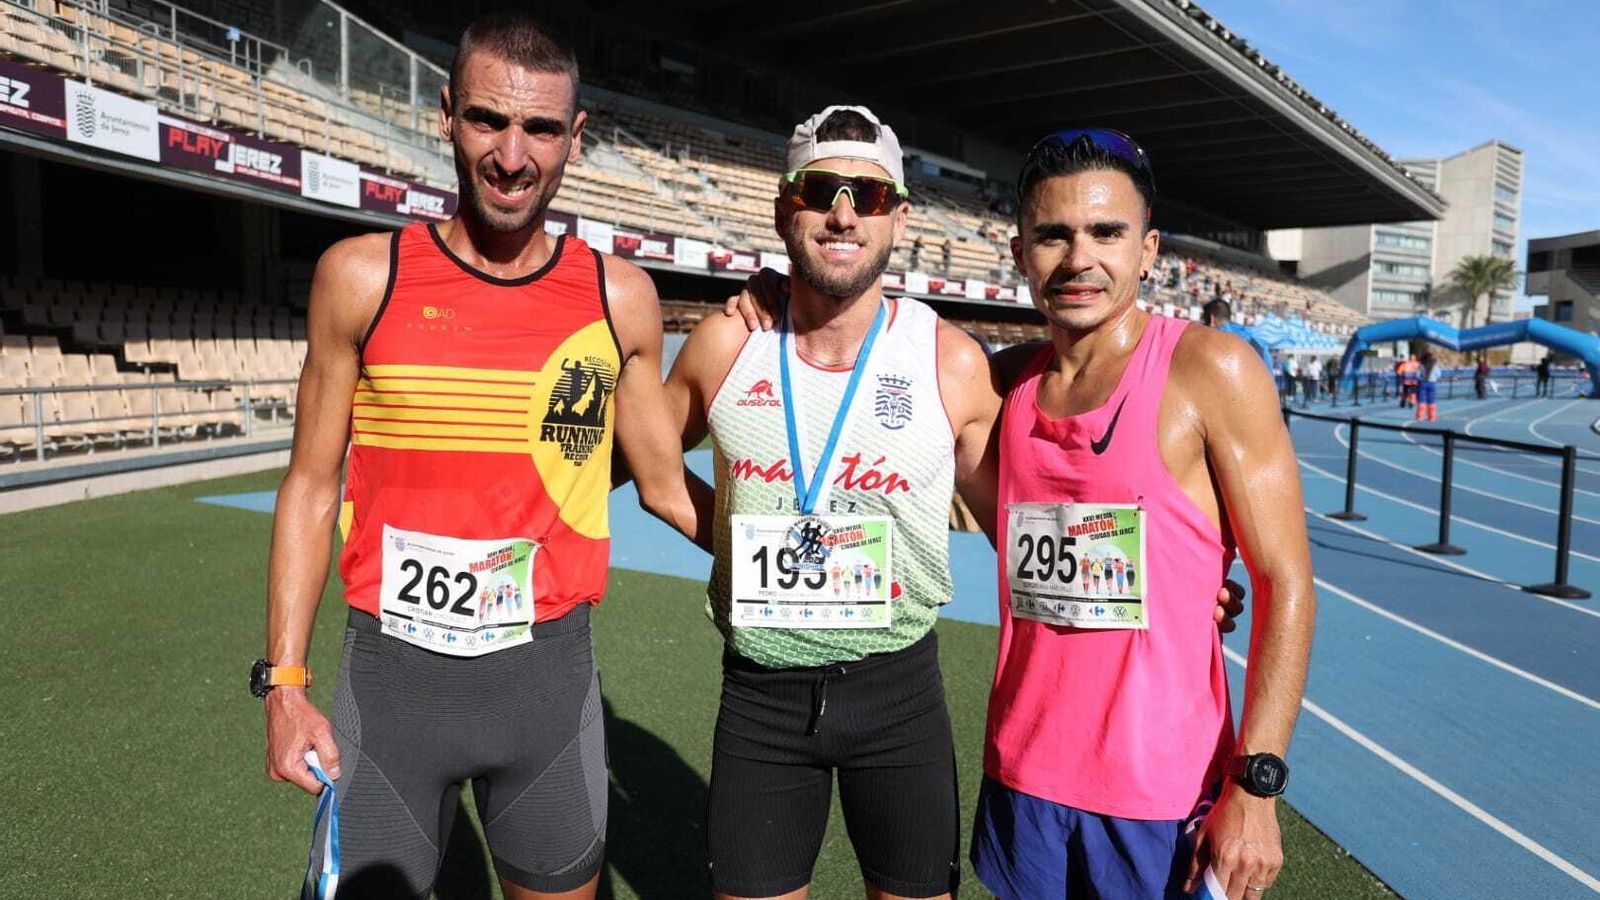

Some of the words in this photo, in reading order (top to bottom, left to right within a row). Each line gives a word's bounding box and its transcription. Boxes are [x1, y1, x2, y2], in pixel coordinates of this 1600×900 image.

[168, 127, 224, 159] PLAY
[215, 142, 283, 174] JEREZ
[365, 180, 404, 202] PLAY
[396, 189, 445, 214] JEREZ
[736, 397, 782, 407] austral
[540, 424, 605, 445] RUNNING
[560, 443, 594, 454] TRAINING
[732, 452, 910, 495] matón
[776, 497, 856, 513] JEEZ
[1016, 533, 1078, 584] 295
[397, 558, 478, 617] 262
